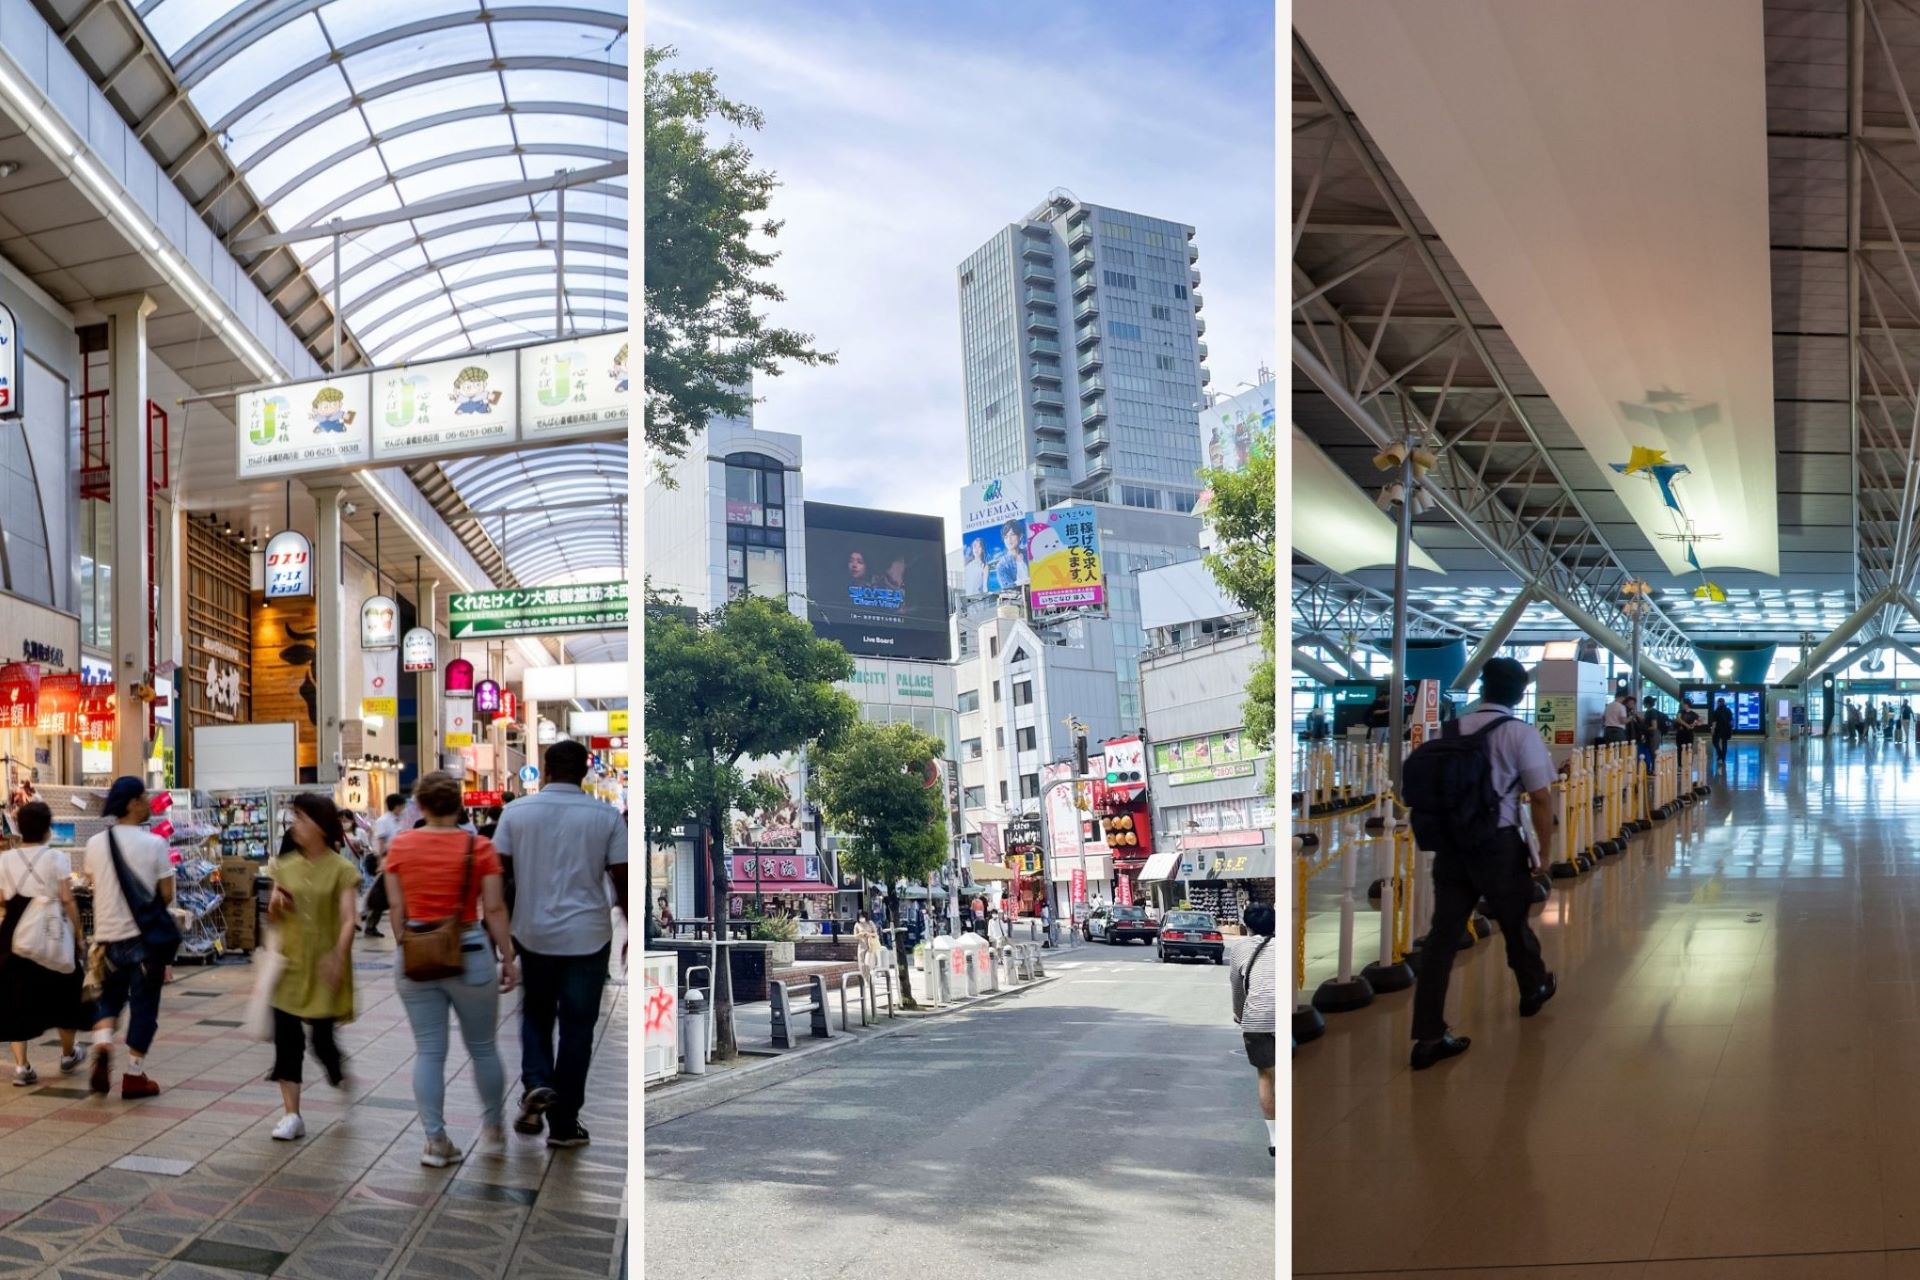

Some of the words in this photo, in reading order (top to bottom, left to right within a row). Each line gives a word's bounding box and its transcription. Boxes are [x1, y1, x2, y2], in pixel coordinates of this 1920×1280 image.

[267, 551, 308, 567] クスリ
[1065, 523, 1082, 583] 揃ってます。
[1080, 522, 1098, 582] 稼げる求人
[896, 673, 933, 688] PALACE
